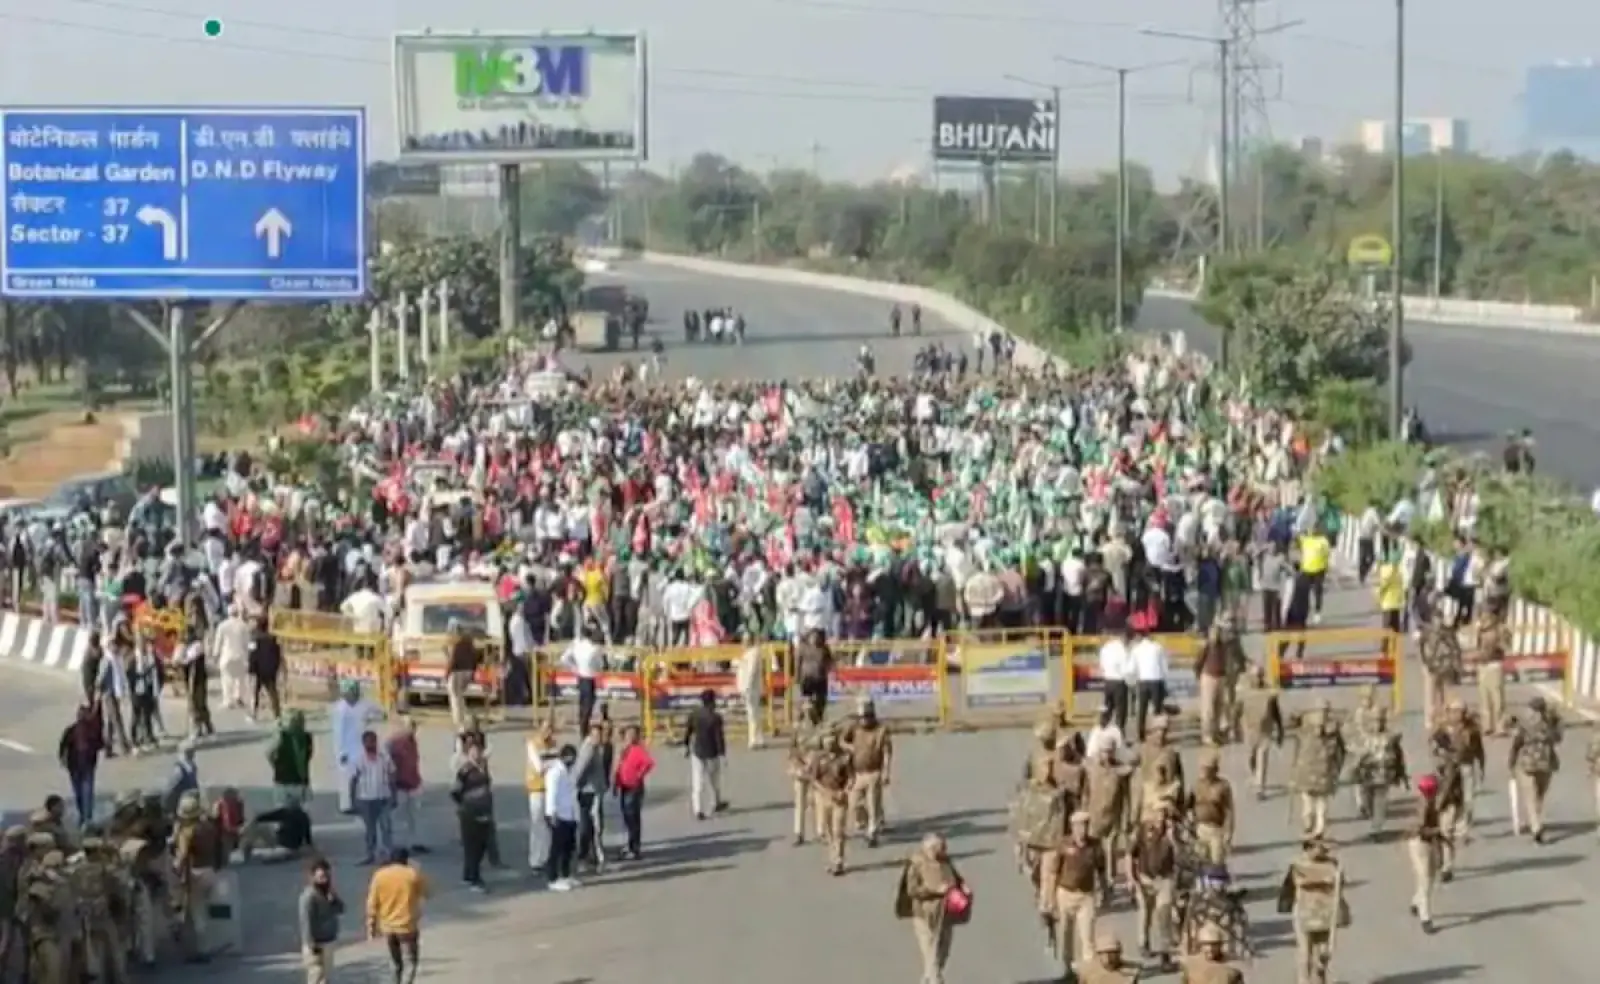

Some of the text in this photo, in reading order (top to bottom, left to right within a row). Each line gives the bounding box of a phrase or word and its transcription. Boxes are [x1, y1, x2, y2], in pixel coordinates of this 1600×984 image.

[454, 46, 586, 96] M3M
[939, 122, 1055, 150] BHUTANI
[8, 161, 176, 181] Botanical Garden
[263, 160, 338, 183] Flyway
[103, 196, 130, 216] 37
[11, 223, 82, 243] Sector
[102, 223, 130, 244] 37
